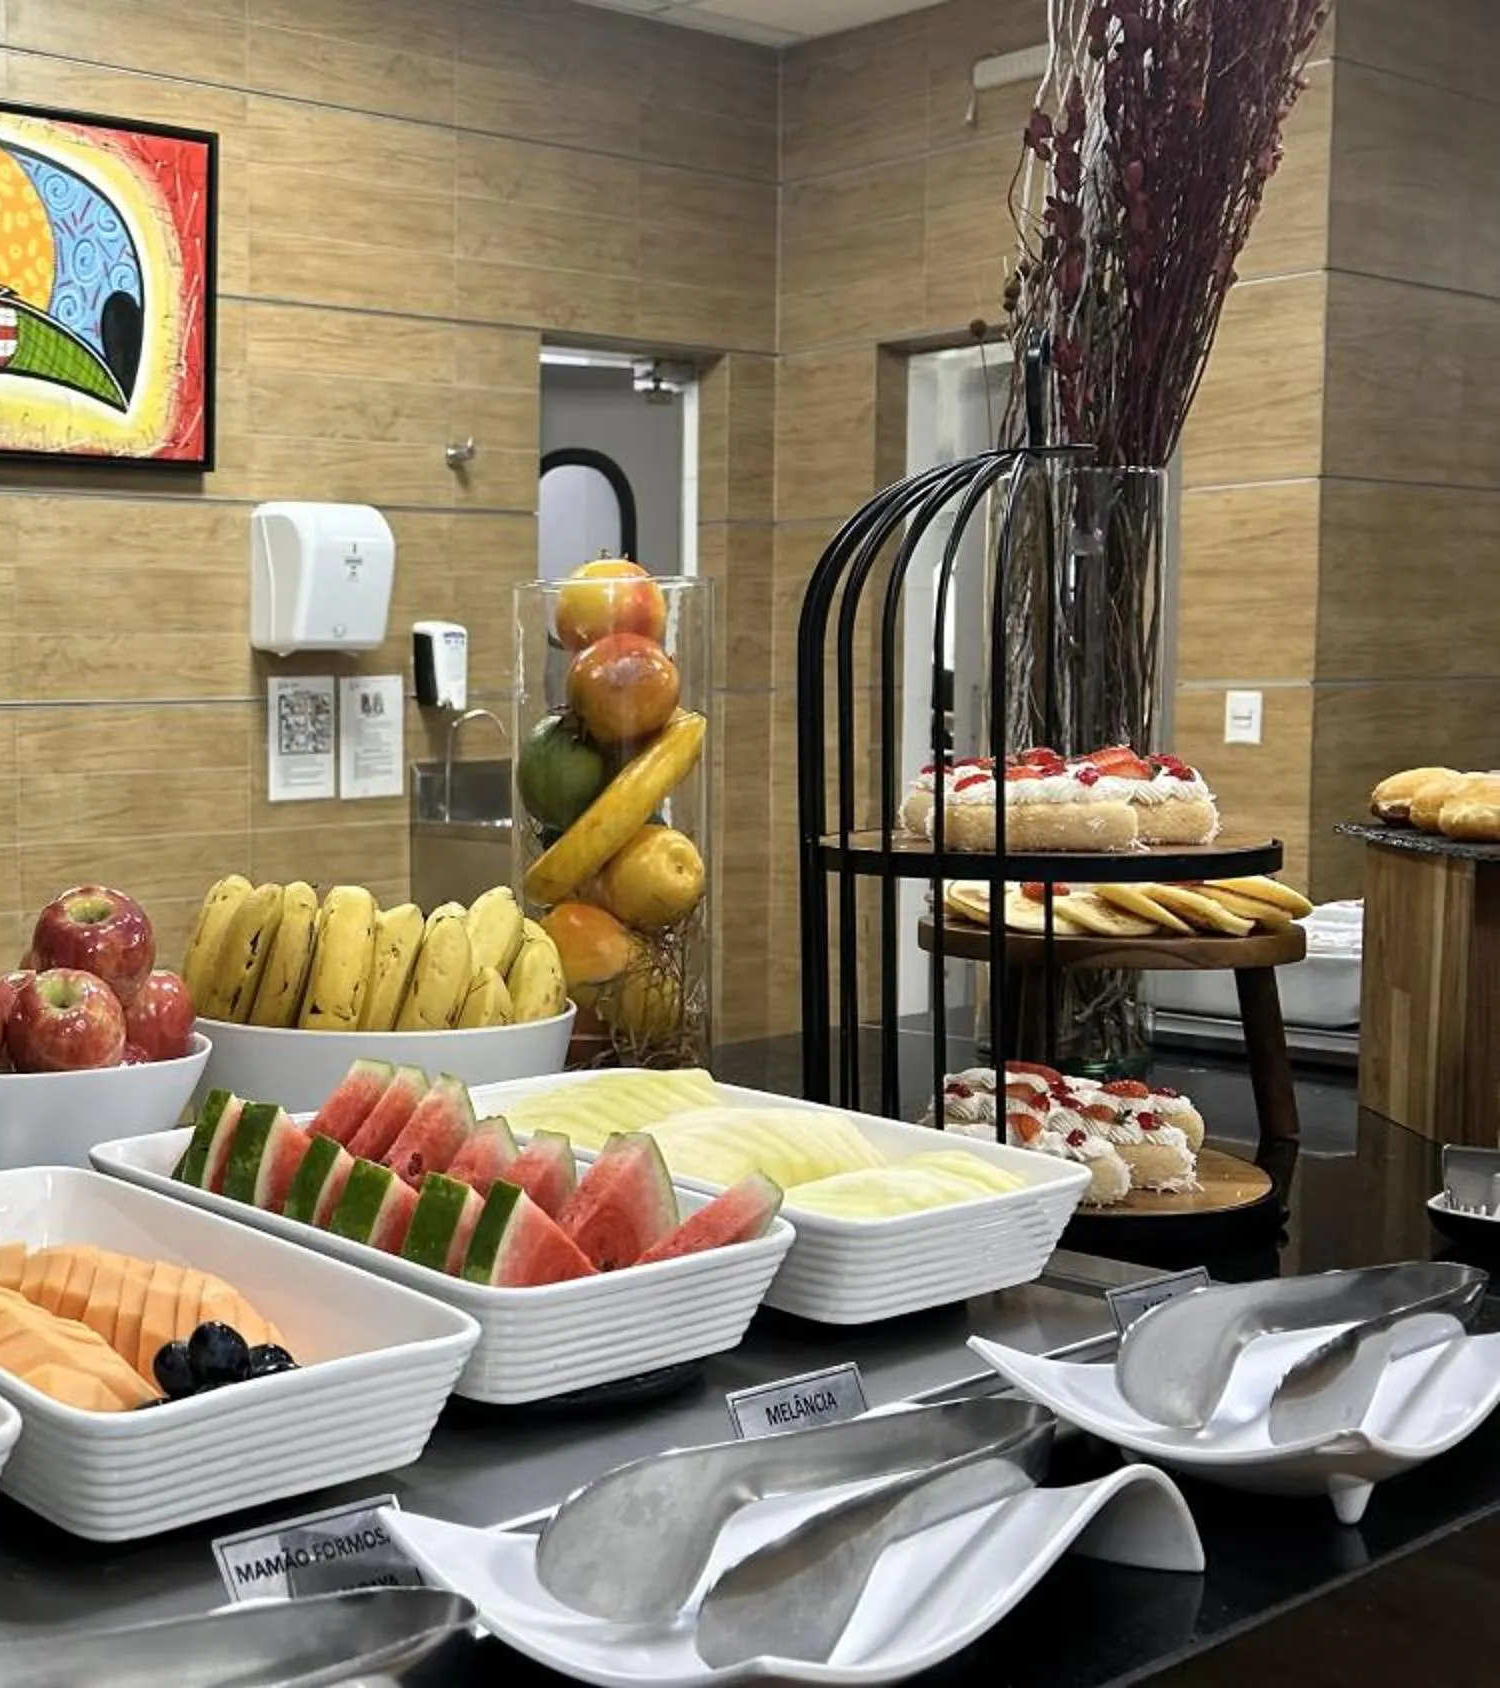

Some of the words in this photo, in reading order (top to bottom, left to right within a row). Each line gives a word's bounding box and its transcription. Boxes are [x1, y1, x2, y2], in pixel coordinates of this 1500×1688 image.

[765, 1391, 838, 1425] MELÂNCIA
[234, 1547, 310, 1585] MAMÃO
[313, 1527, 390, 1562] FORMOS
